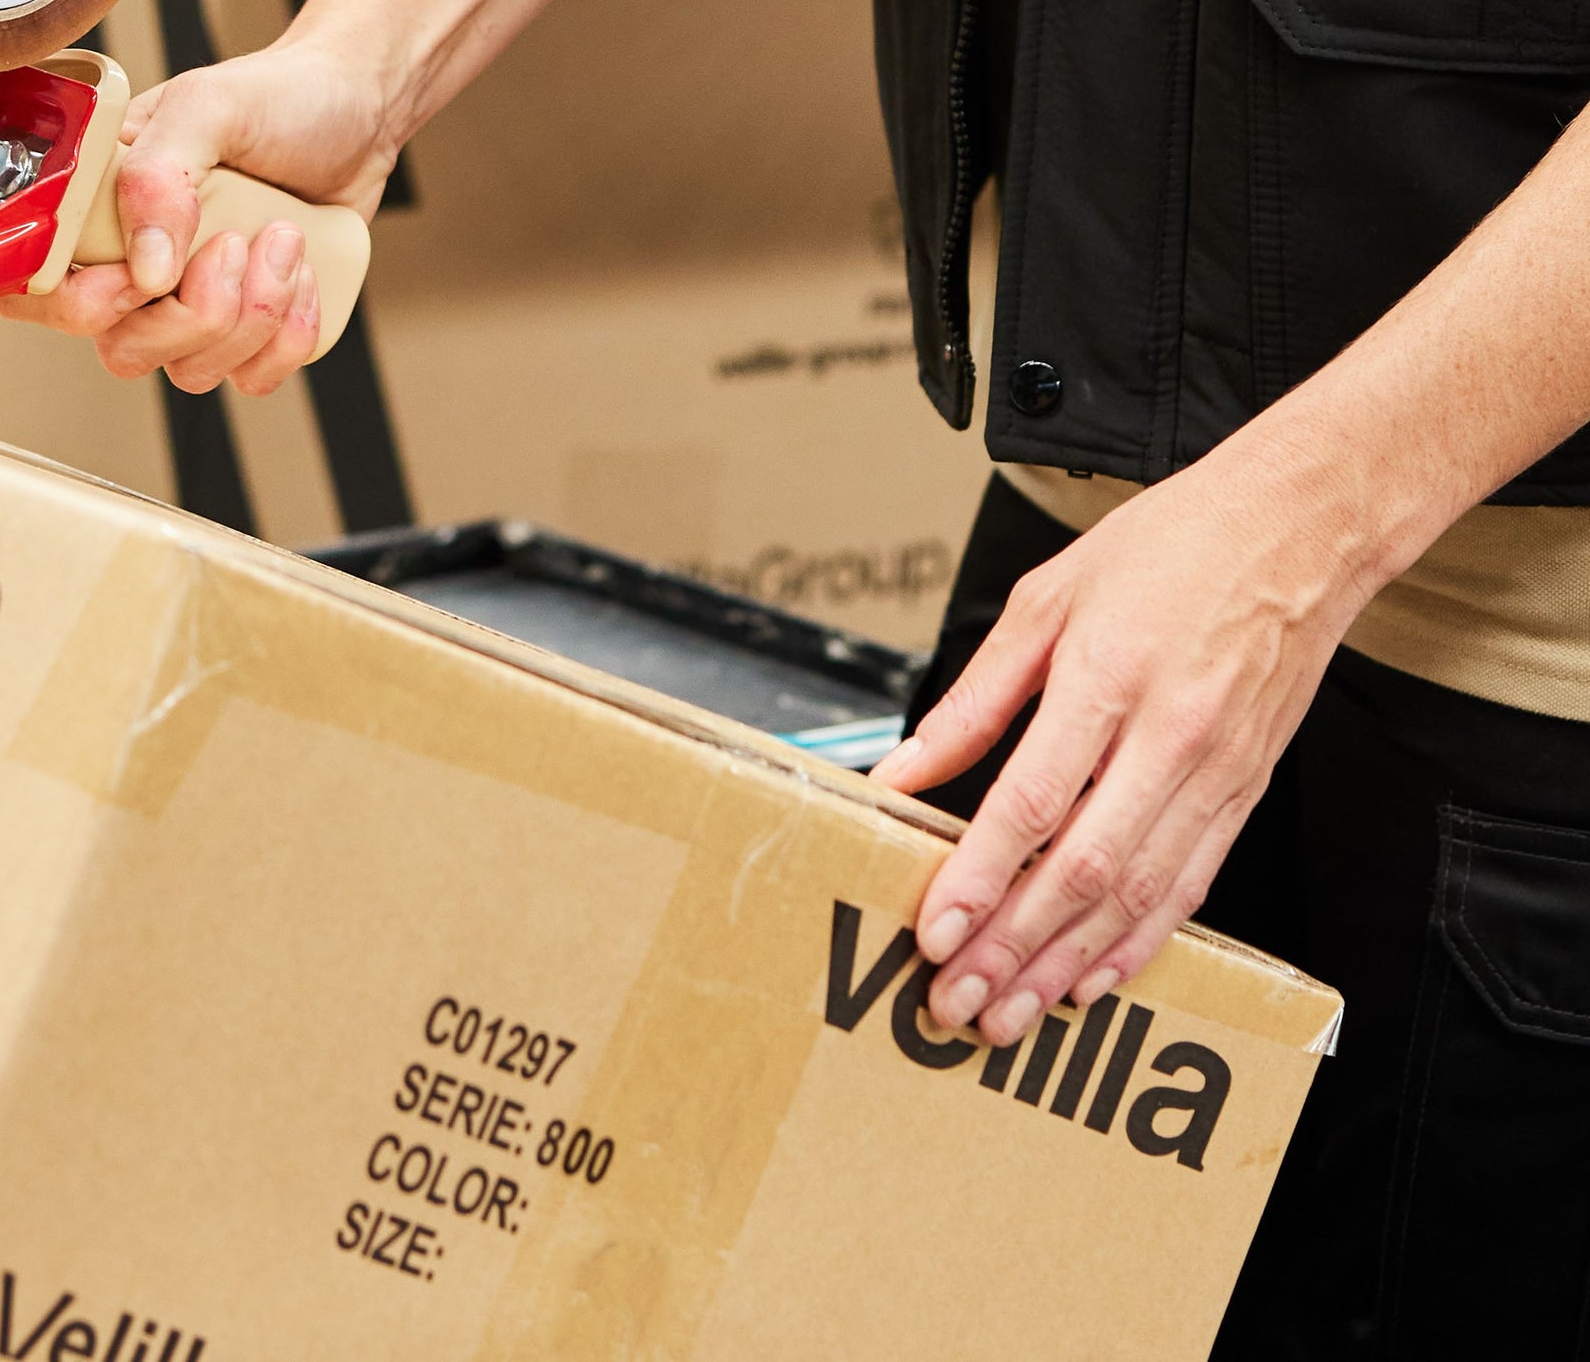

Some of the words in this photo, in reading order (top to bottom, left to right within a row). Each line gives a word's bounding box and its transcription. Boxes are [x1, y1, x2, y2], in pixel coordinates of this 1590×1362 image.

[424, 996, 578, 1086] C01297
[393, 1063, 533, 1156] SERIE:
[535, 1119, 617, 1186] 800
[366, 1132, 530, 1235] COLOR:
[335, 1201, 445, 1282] SIZE:
